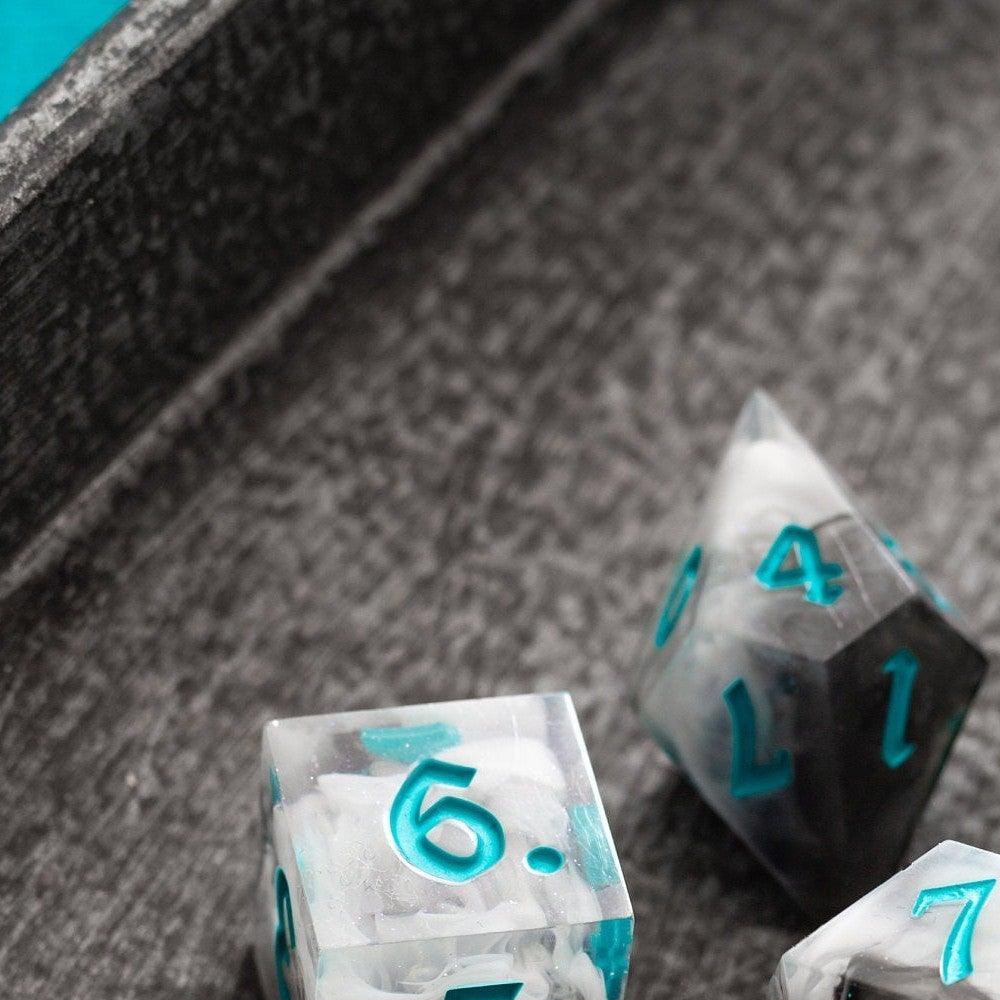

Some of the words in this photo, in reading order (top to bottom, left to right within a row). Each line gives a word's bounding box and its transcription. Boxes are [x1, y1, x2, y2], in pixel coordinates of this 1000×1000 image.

[755, 525, 845, 606] 4
[723, 677, 793, 801] 7
[881, 648, 920, 768] 1
[911, 878, 997, 986] 7
